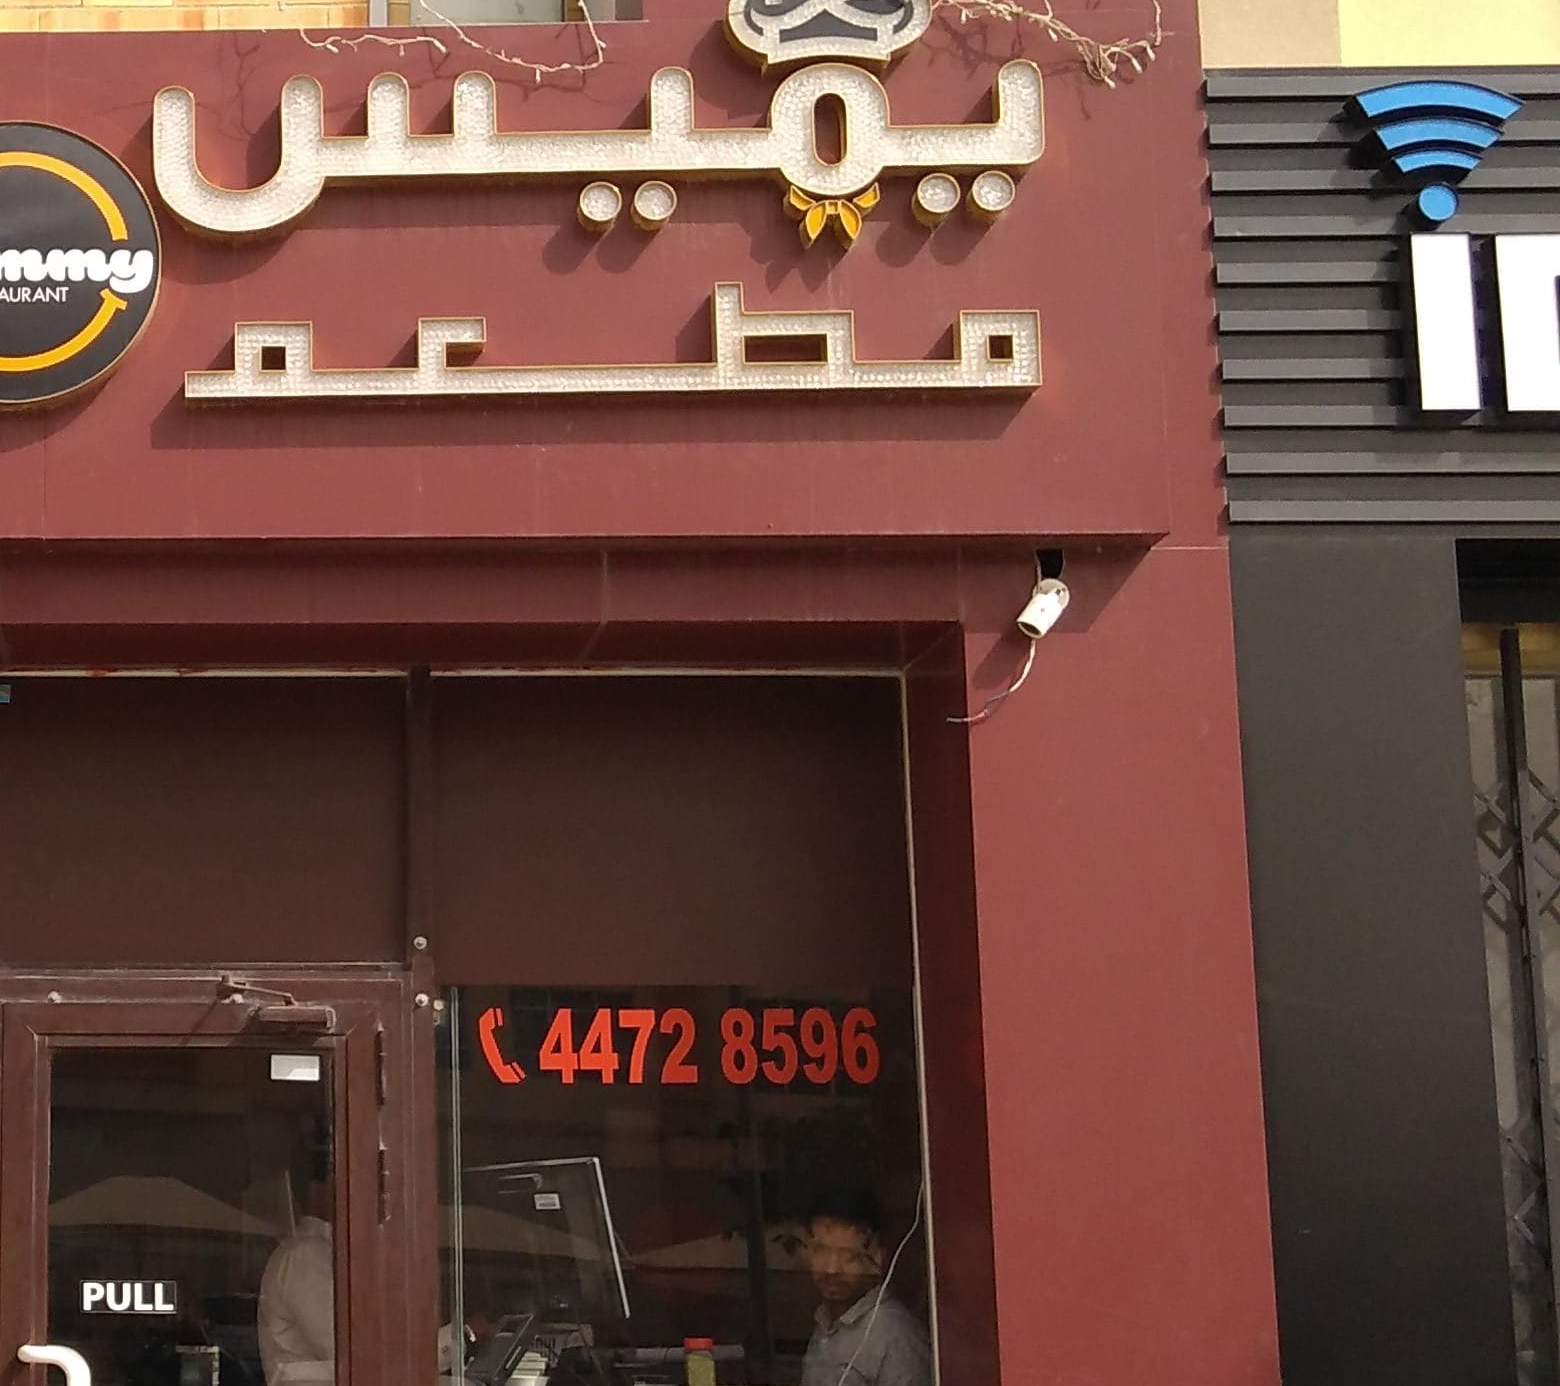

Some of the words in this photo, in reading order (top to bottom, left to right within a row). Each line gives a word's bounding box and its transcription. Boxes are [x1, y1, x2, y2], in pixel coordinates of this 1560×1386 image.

[182, 280, 1044, 405] مطعم
[538, 1007, 699, 1084] 4472
[720, 1006, 881, 1085] 8596
[81, 1281, 175, 1312] PULL
